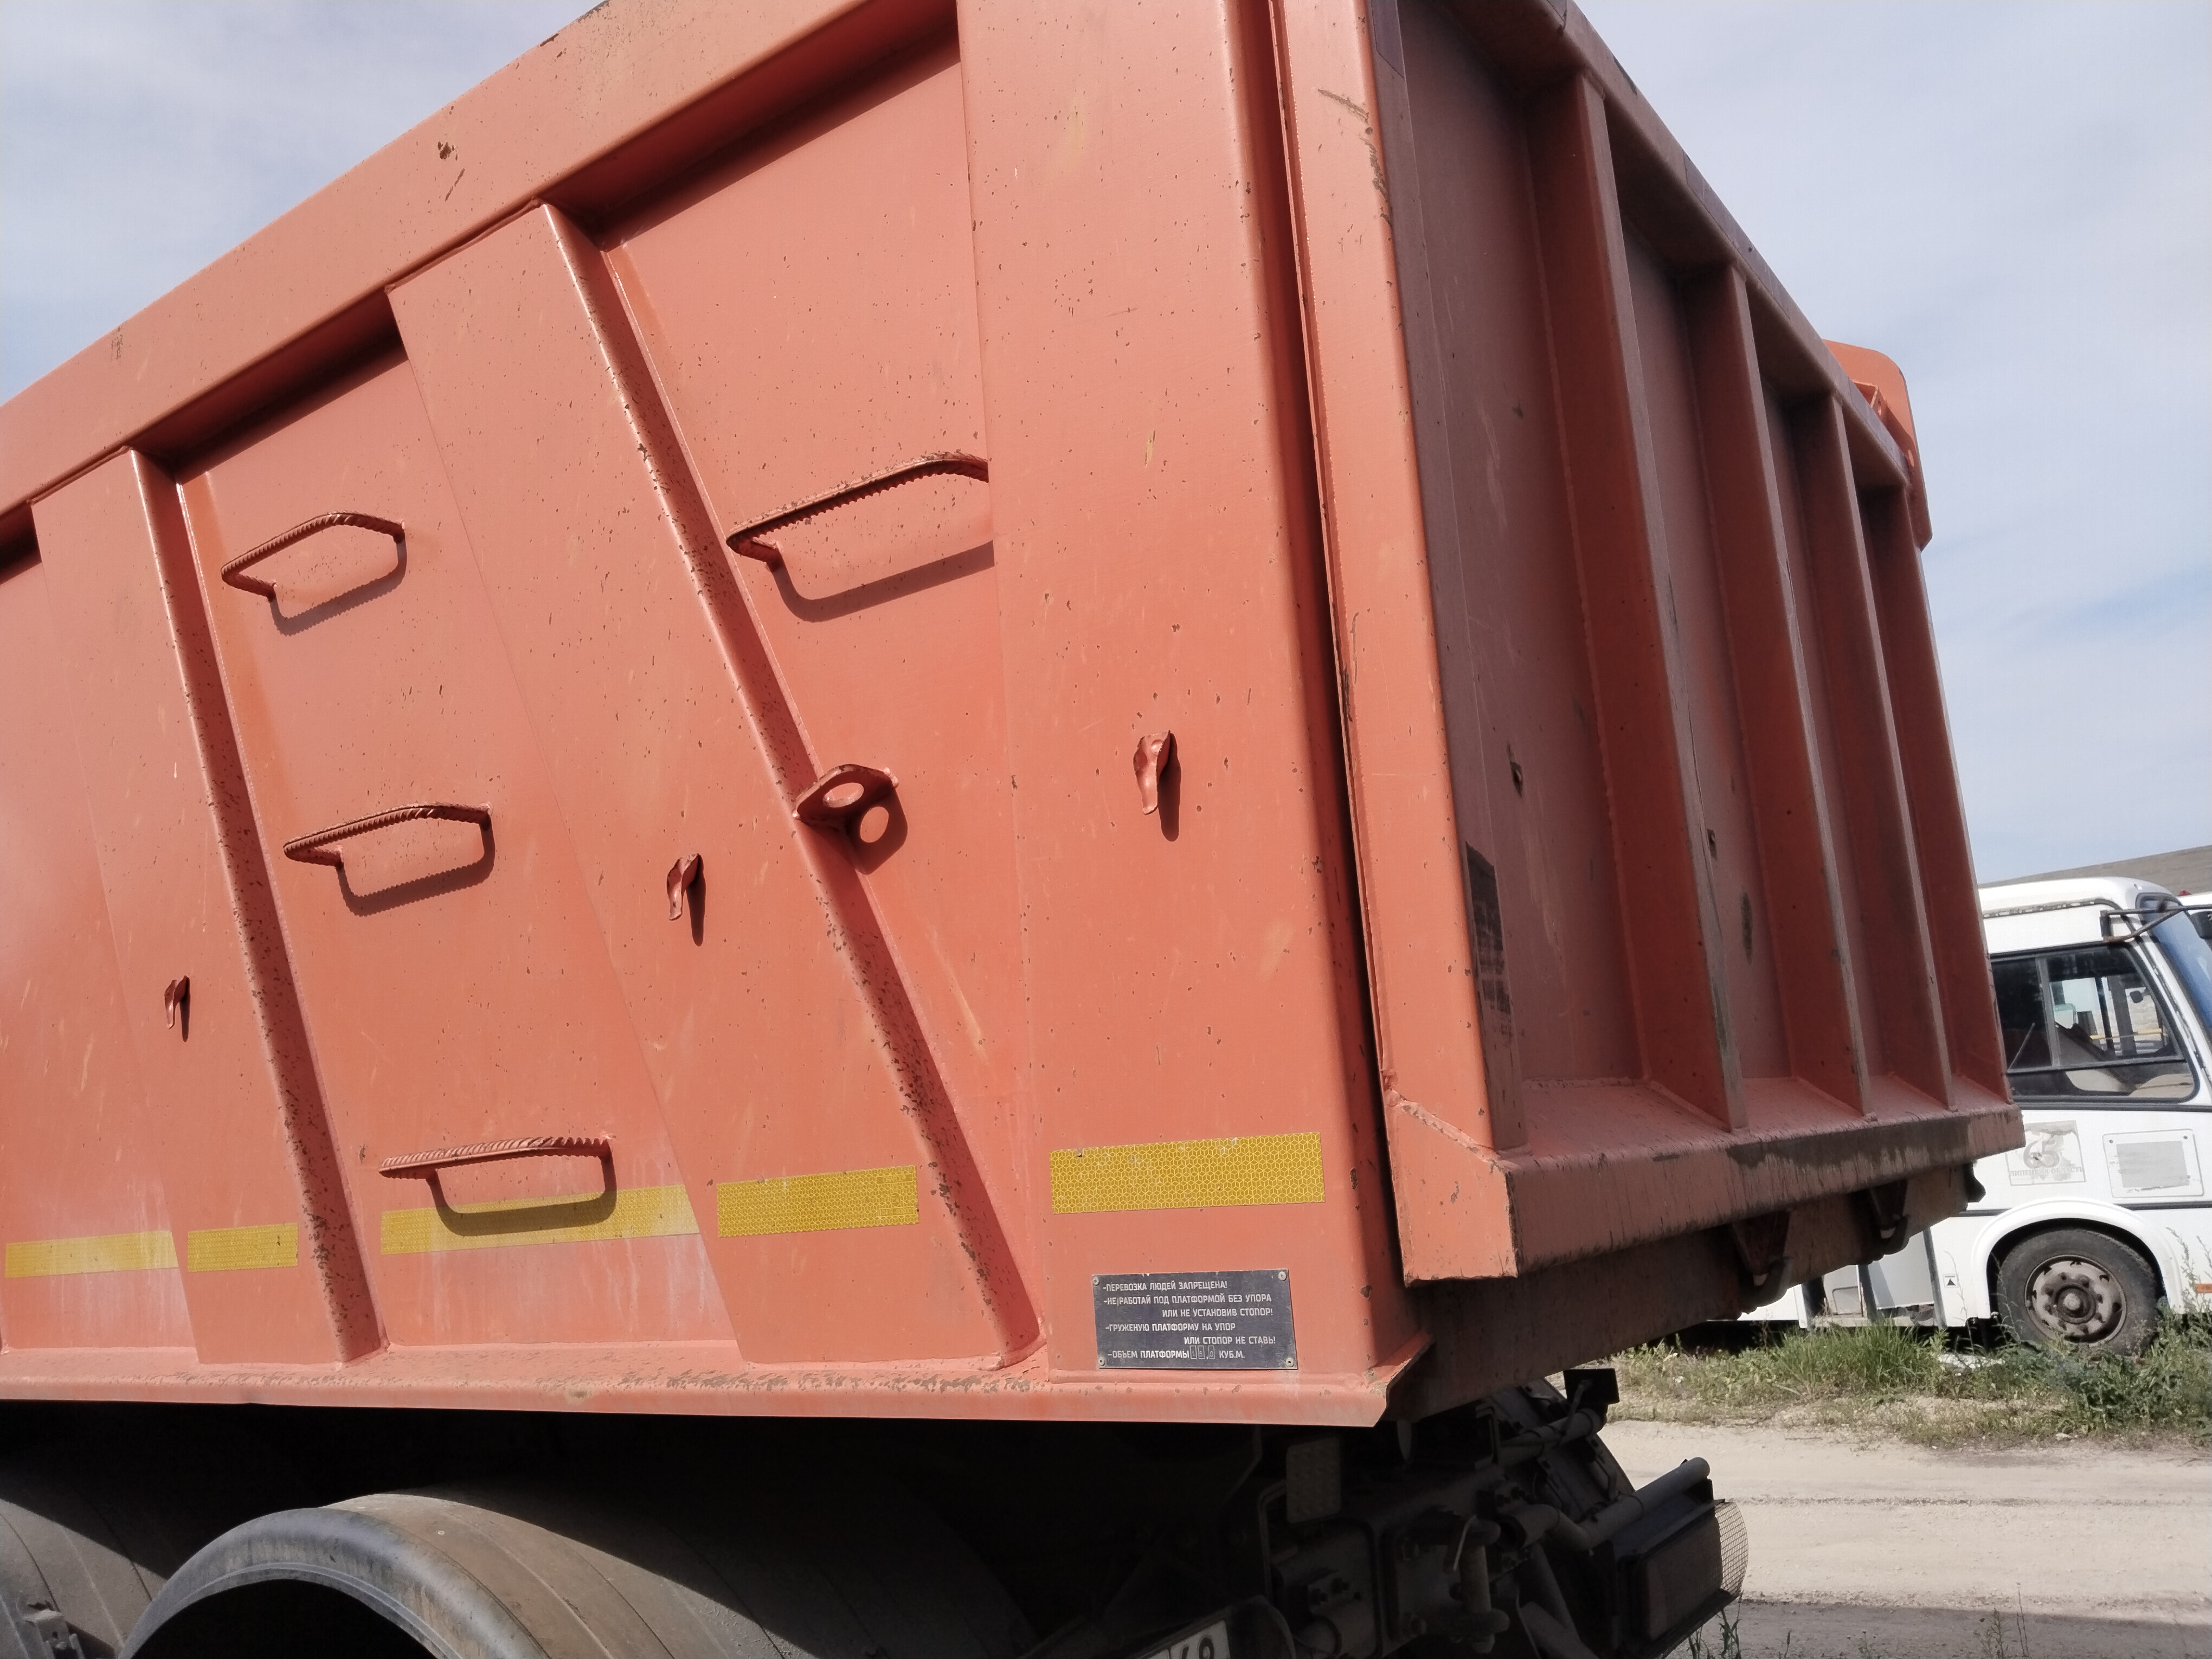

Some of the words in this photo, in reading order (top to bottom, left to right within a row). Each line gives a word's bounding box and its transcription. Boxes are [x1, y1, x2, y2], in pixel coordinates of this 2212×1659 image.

[1149, 1280, 1176, 1291] ЛЮДЕЙ
[1179, 1281, 1227, 1290] ЗАПРЕЩЕНА!
[1119, 1295, 1151, 1304] РАБОТАЙ
[1154, 1296, 1169, 1305] ПОД
[1172, 1293, 1225, 1303] ПЛАТФОРМОЙ
[1245, 1294, 1272, 1302] УПОРА
[1162, 1309, 1178, 1317] ИЛИ
[1180, 1309, 1190, 1317] НЕ
[1192, 1308, 1237, 1316] УСТАНОВИВ
[1240, 1308, 1273, 1316] СТОПОР!
[1140, 1350, 1189, 1359] ПЛАТФОРМЫ
